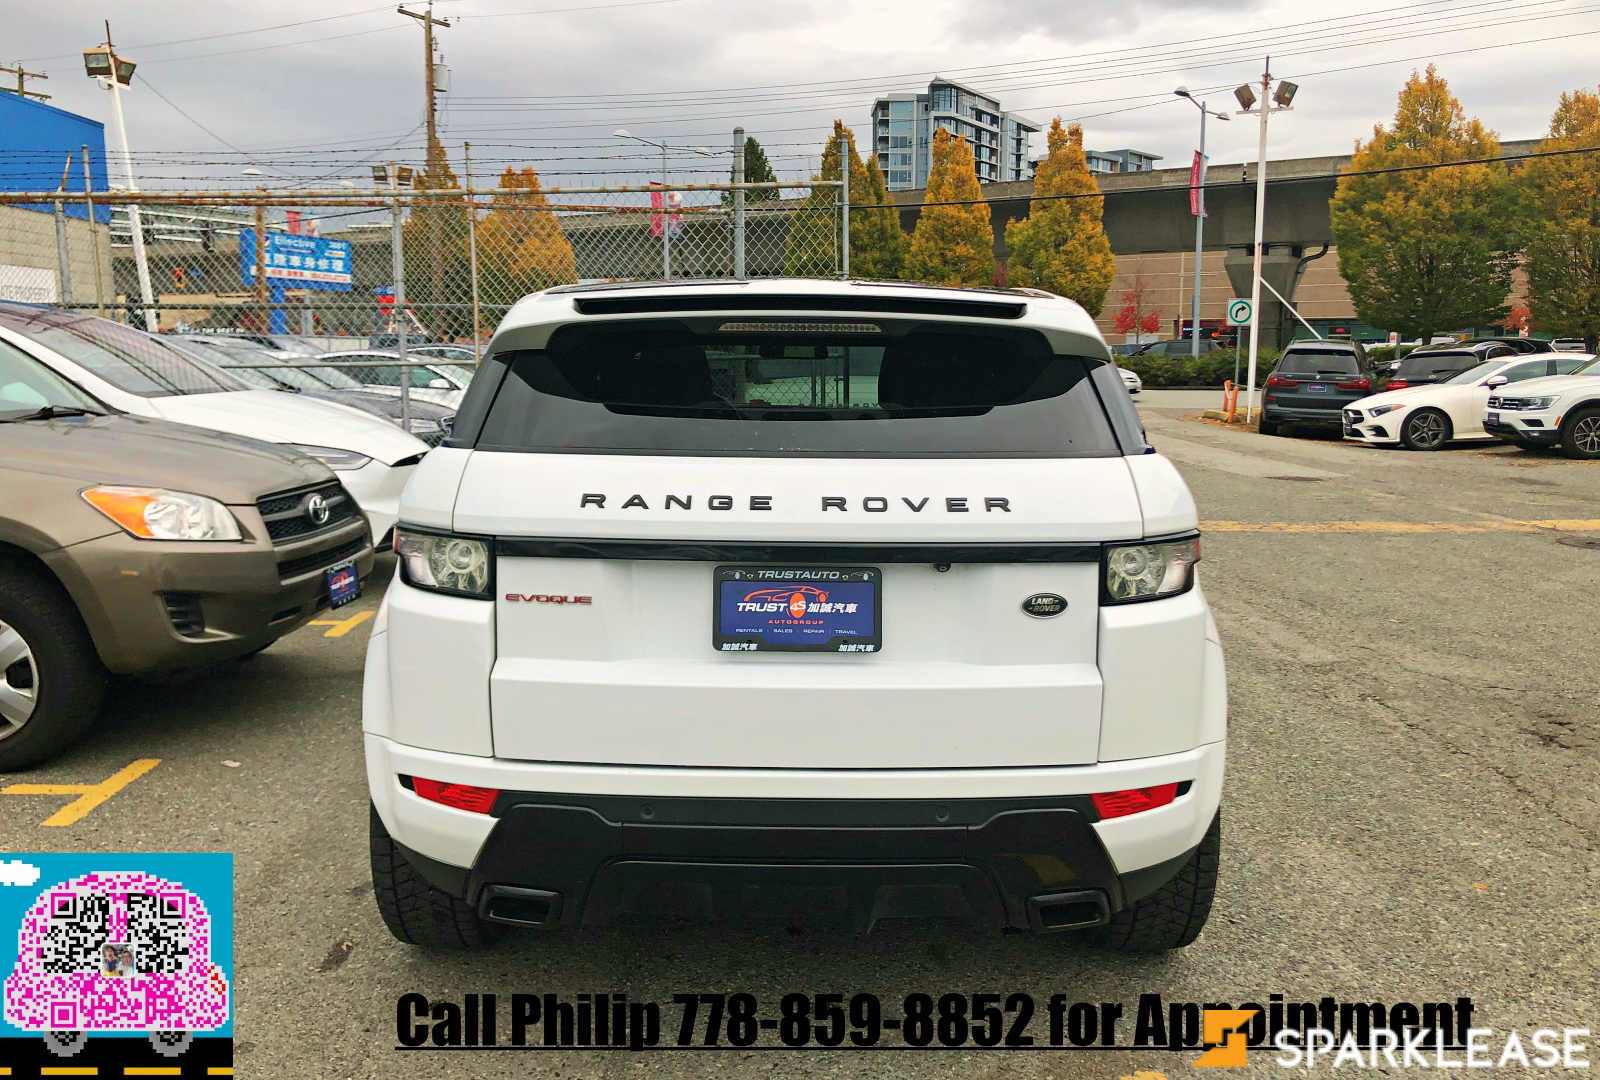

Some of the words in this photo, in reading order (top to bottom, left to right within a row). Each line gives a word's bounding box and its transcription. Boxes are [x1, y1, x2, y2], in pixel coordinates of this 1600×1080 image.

[580, 493, 773, 511] RANGE
[821, 496, 1012, 513] ROVER
[757, 570, 840, 579] TRUSTAUTO
[505, 593, 592, 605] EVOQUE
[737, 602, 787, 612] TRUST
[1033, 604, 1060, 612] ROVER
